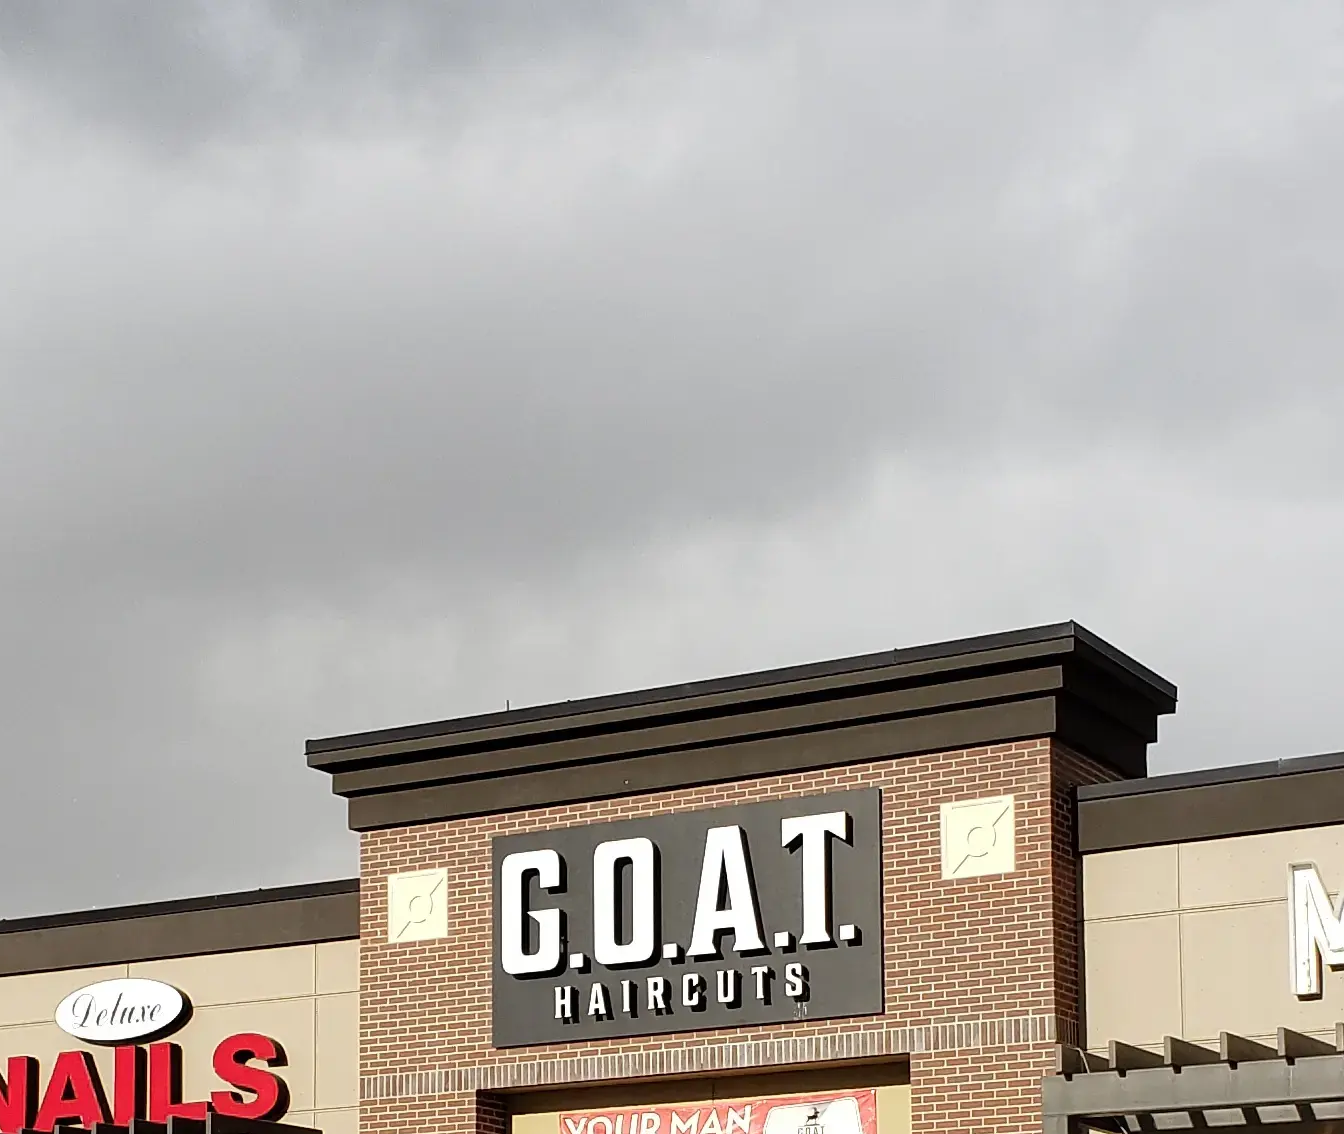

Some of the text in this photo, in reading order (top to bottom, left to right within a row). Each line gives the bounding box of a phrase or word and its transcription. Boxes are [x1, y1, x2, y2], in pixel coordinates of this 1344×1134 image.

[501, 811, 855, 975] G.O.A.T.
[71, 992, 165, 1029] Deluxe
[554, 962, 803, 1019] HAIRCUTS
